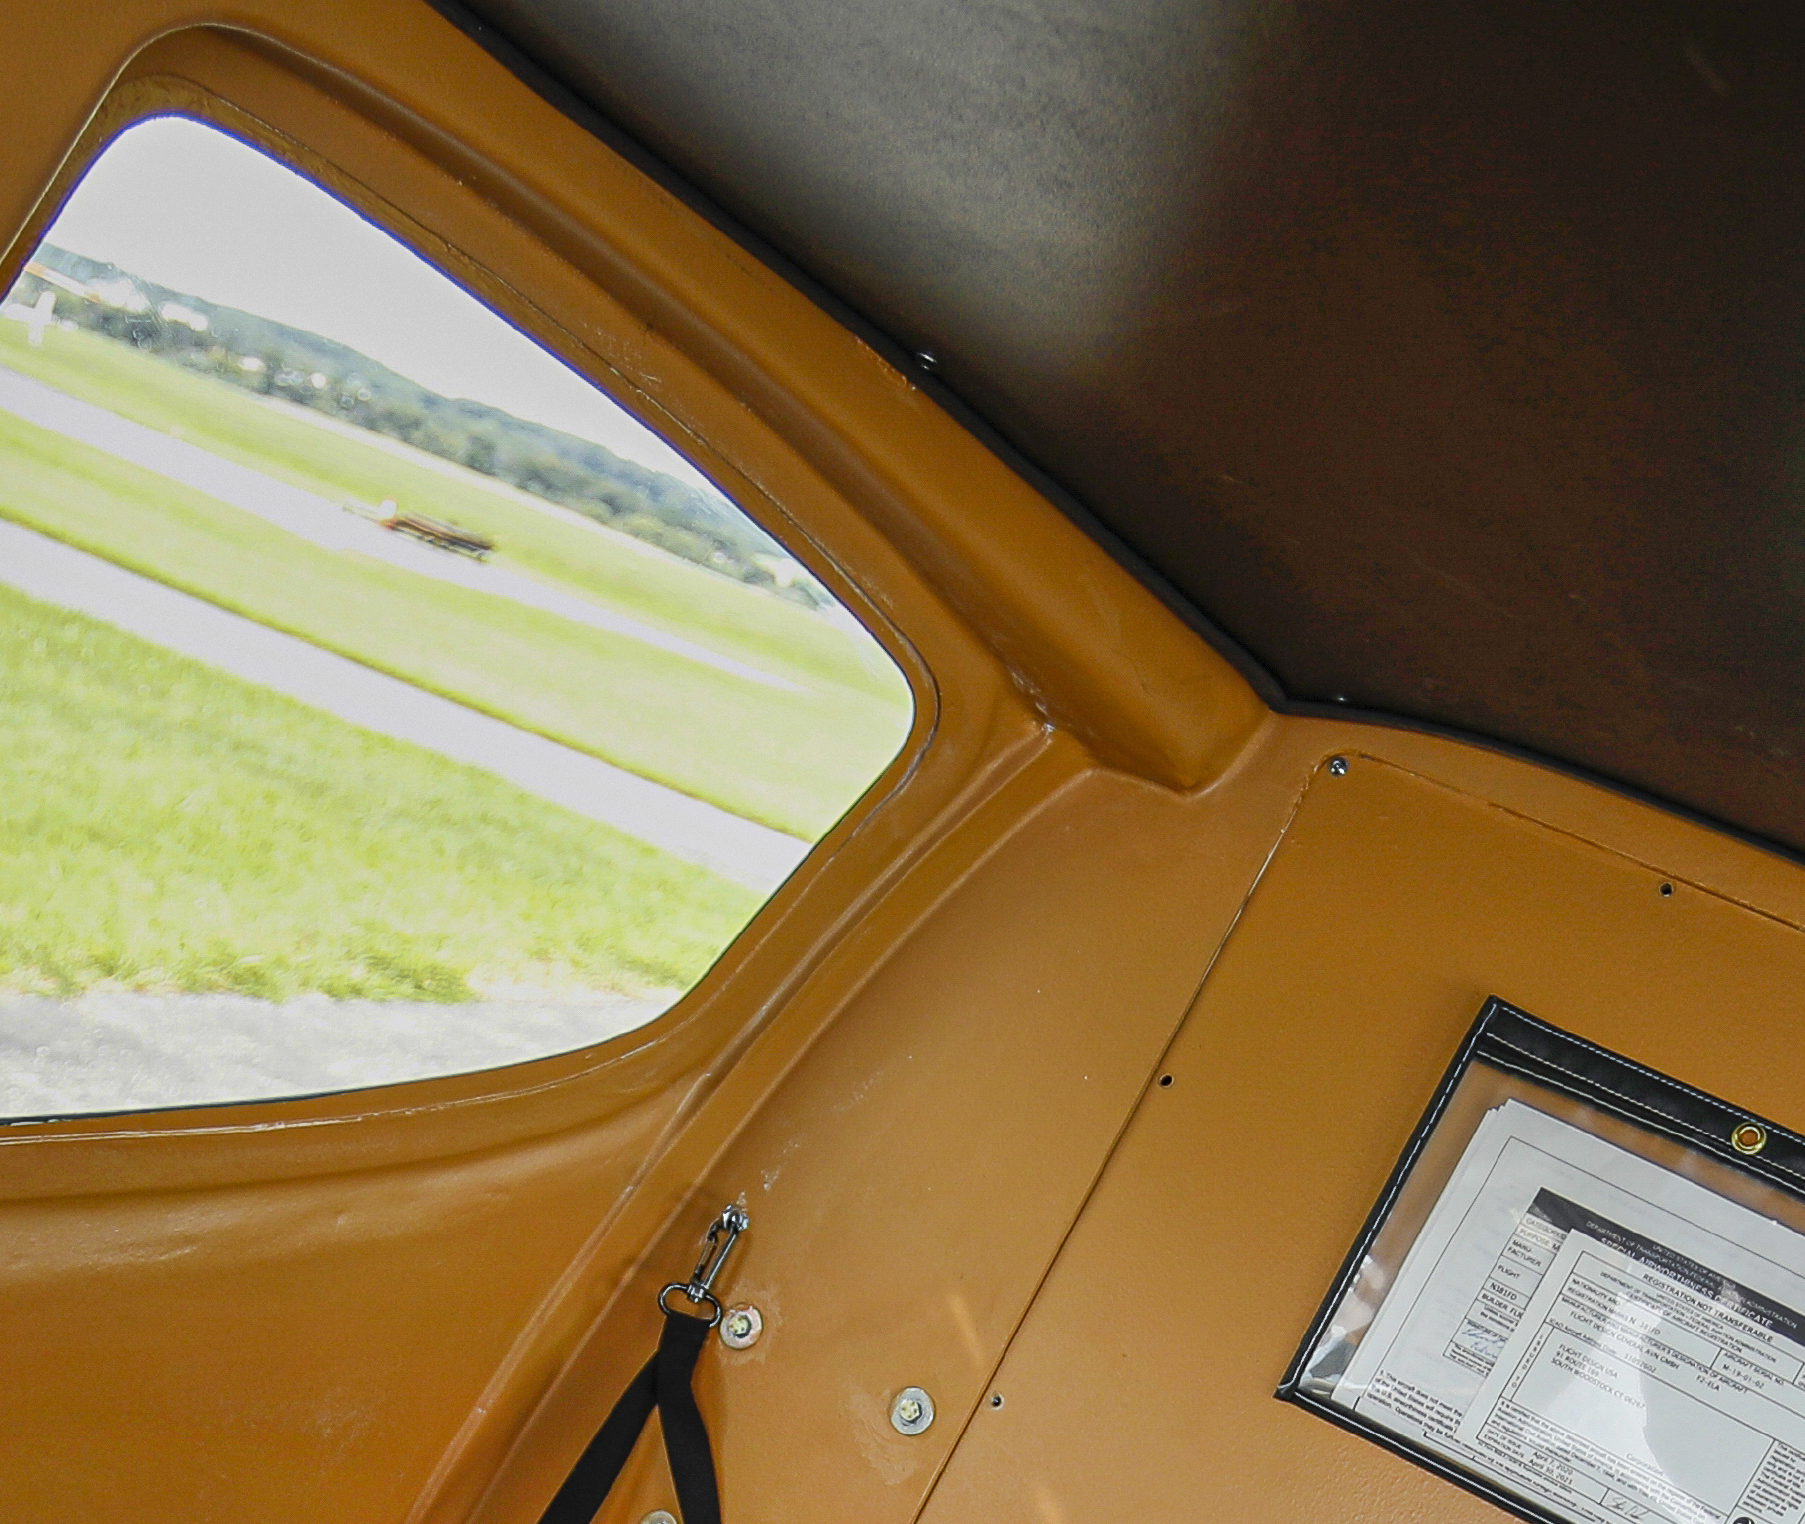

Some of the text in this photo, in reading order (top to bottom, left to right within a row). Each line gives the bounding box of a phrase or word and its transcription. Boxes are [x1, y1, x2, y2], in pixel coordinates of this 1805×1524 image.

[1641, 1273, 1773, 1343] REGISTRATION NOT TRANSFERABLE
[1558, 1342, 1582, 1359] FLIGHT
